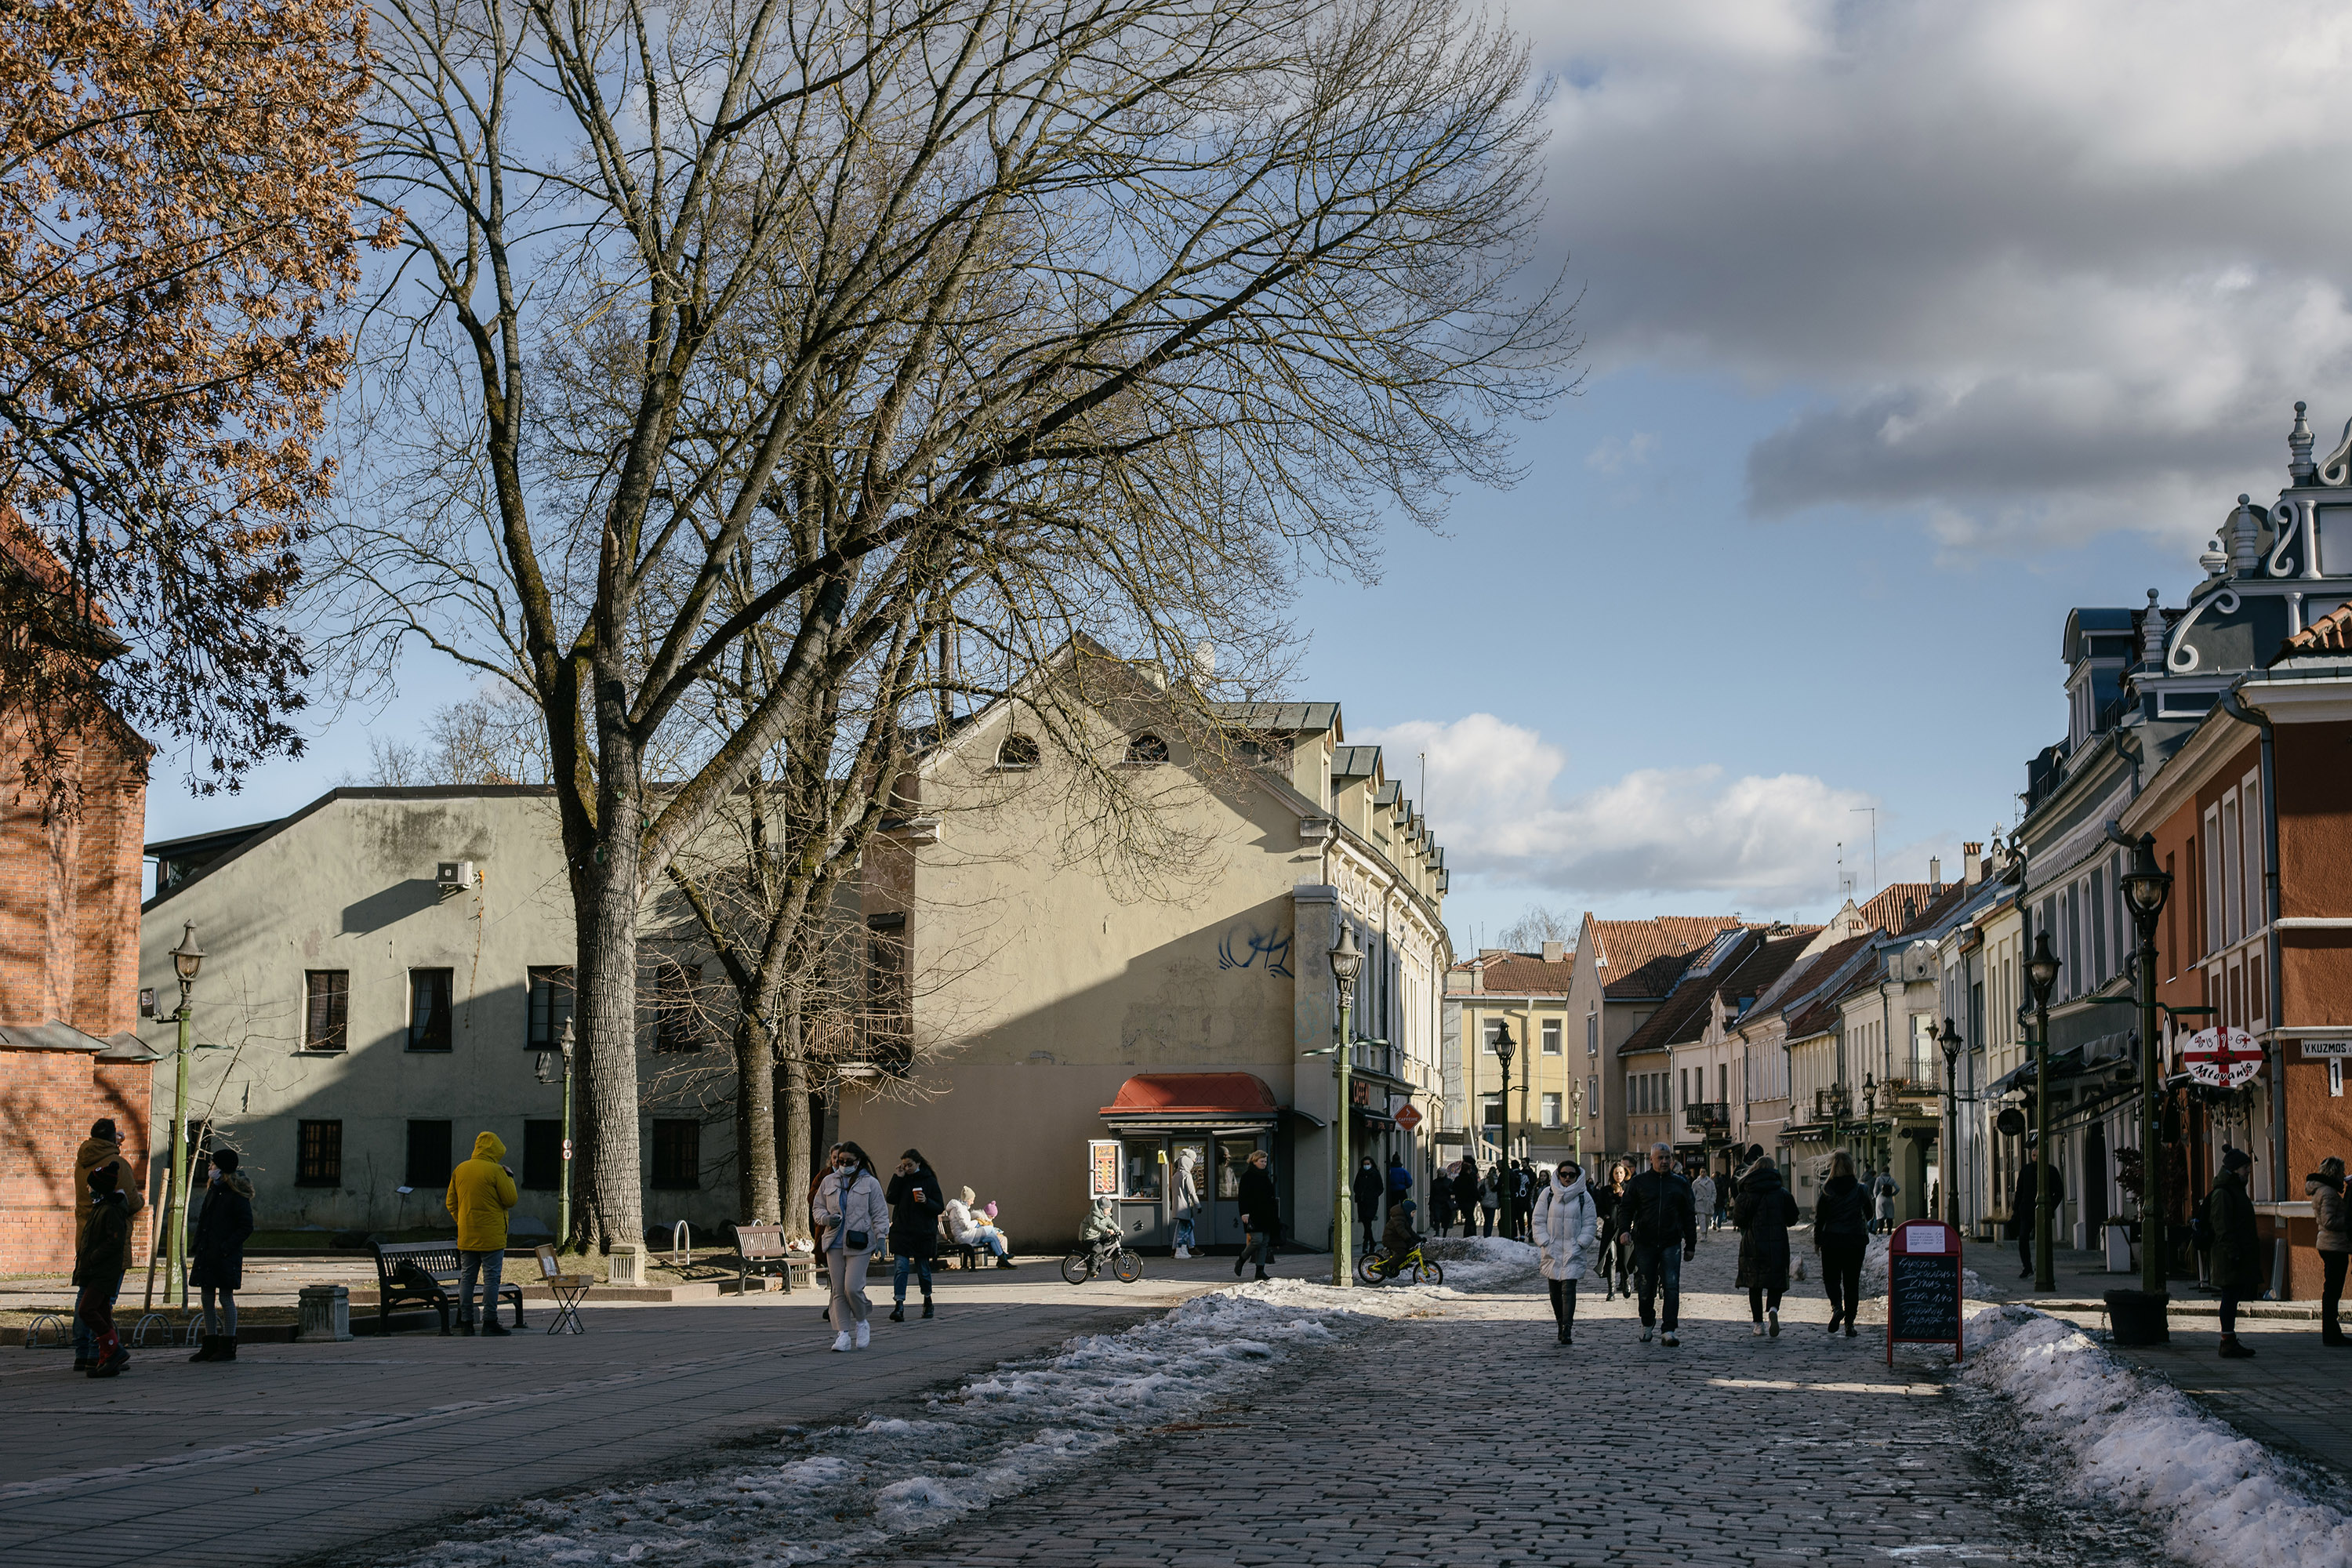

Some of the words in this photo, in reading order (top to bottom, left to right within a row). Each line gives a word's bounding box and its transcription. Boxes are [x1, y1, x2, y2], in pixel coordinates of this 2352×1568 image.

[2305, 1044, 2347, 1054] V.KUZMOS
[2193, 1062, 2252, 1080] Mtevanis
[2332, 1063, 2339, 1088] 1
